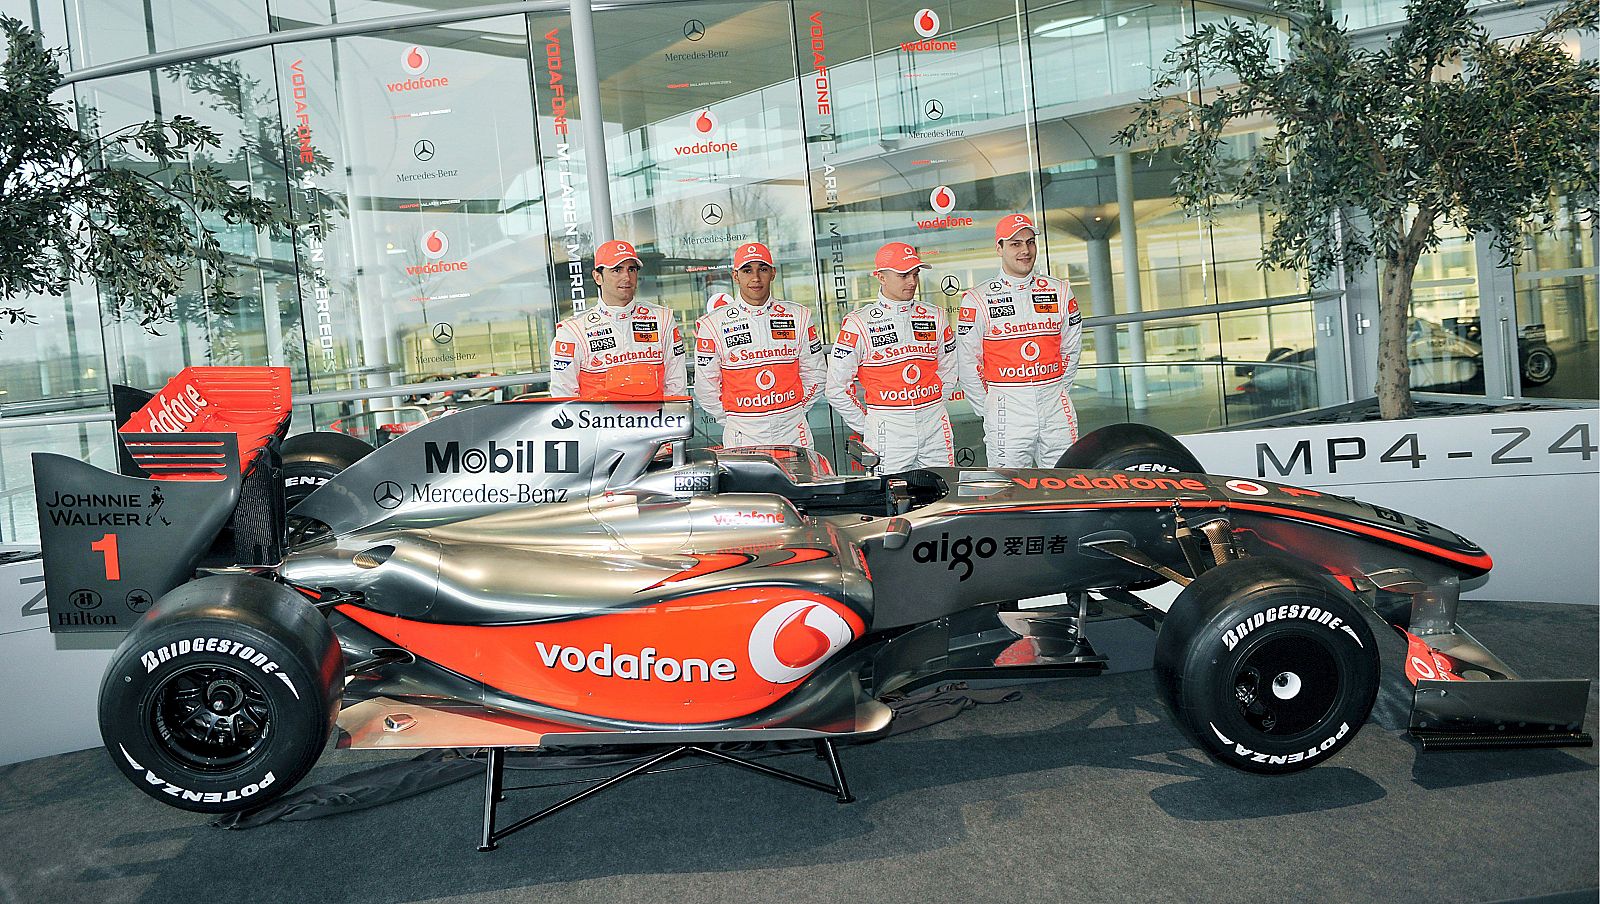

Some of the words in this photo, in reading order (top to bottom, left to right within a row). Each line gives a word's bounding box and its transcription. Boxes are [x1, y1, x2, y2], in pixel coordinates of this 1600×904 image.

[900, 39, 957, 53] vodafone
[665, 50, 729, 62] Mercedes-Benz
[387, 76, 449, 93] vodafone
[545, 28, 568, 136] VODAFONE
[290, 59, 314, 165] VODAFONE
[908, 128, 965, 139] Mercedes-Benz
[674, 140, 738, 156] vodafone
[808, 11, 831, 116] VODAFONE
[829, 221, 848, 312] MERCEDE
[396, 168, 458, 182] Mercedes-Benz
[917, 215, 973, 230] vodafone
[683, 233, 747, 246] Mercedes-Benz
[406, 259, 468, 276] vodafone
[991, 305, 1013, 315] BOSS
[958, 326, 969, 334] SAP
[1004, 318, 1061, 334] Santander
[590, 337, 615, 350] BOSS
[726, 333, 750, 346] BOSS
[872, 332, 897, 345] BOSS
[415, 352, 476, 364] Mercedes-Benz
[604, 347, 663, 365] Santander
[740, 344, 797, 361] Santander
[834, 349, 847, 359] SAP
[884, 343, 938, 359] Santande
[554, 360, 567, 370] SAP
[698, 357, 710, 365] SAP
[999, 362, 1059, 378] vodafone
[736, 389, 796, 407] vodafone
[880, 383, 940, 401] vodafone
[141, 384, 208, 433] dafone
[578, 409, 686, 430] Santander
[424, 440, 534, 474] Mobil
[1255, 423, 1598, 478] MP4-24
[675, 476, 709, 488] BOSS
[1012, 474, 1208, 491] vodafone
[46, 490, 142, 508] JOHNNIE
[411, 483, 568, 503] Mercedes-Benz
[49, 510, 141, 527] WALKER
[714, 510, 785, 526] vodafone
[91, 533, 121, 581] 1
[912, 532, 998, 582] aigo
[1003, 535, 1068, 556] 爱国者
[58, 611, 117, 626] Hilton
[1221, 604, 1342, 651] BRIDGESTONE
[141, 637, 279, 674] BRIDGESTONE
[535, 641, 737, 682] vodafone
[1234, 721, 1350, 765] POTENZA
[144, 770, 276, 803] POTENZA
